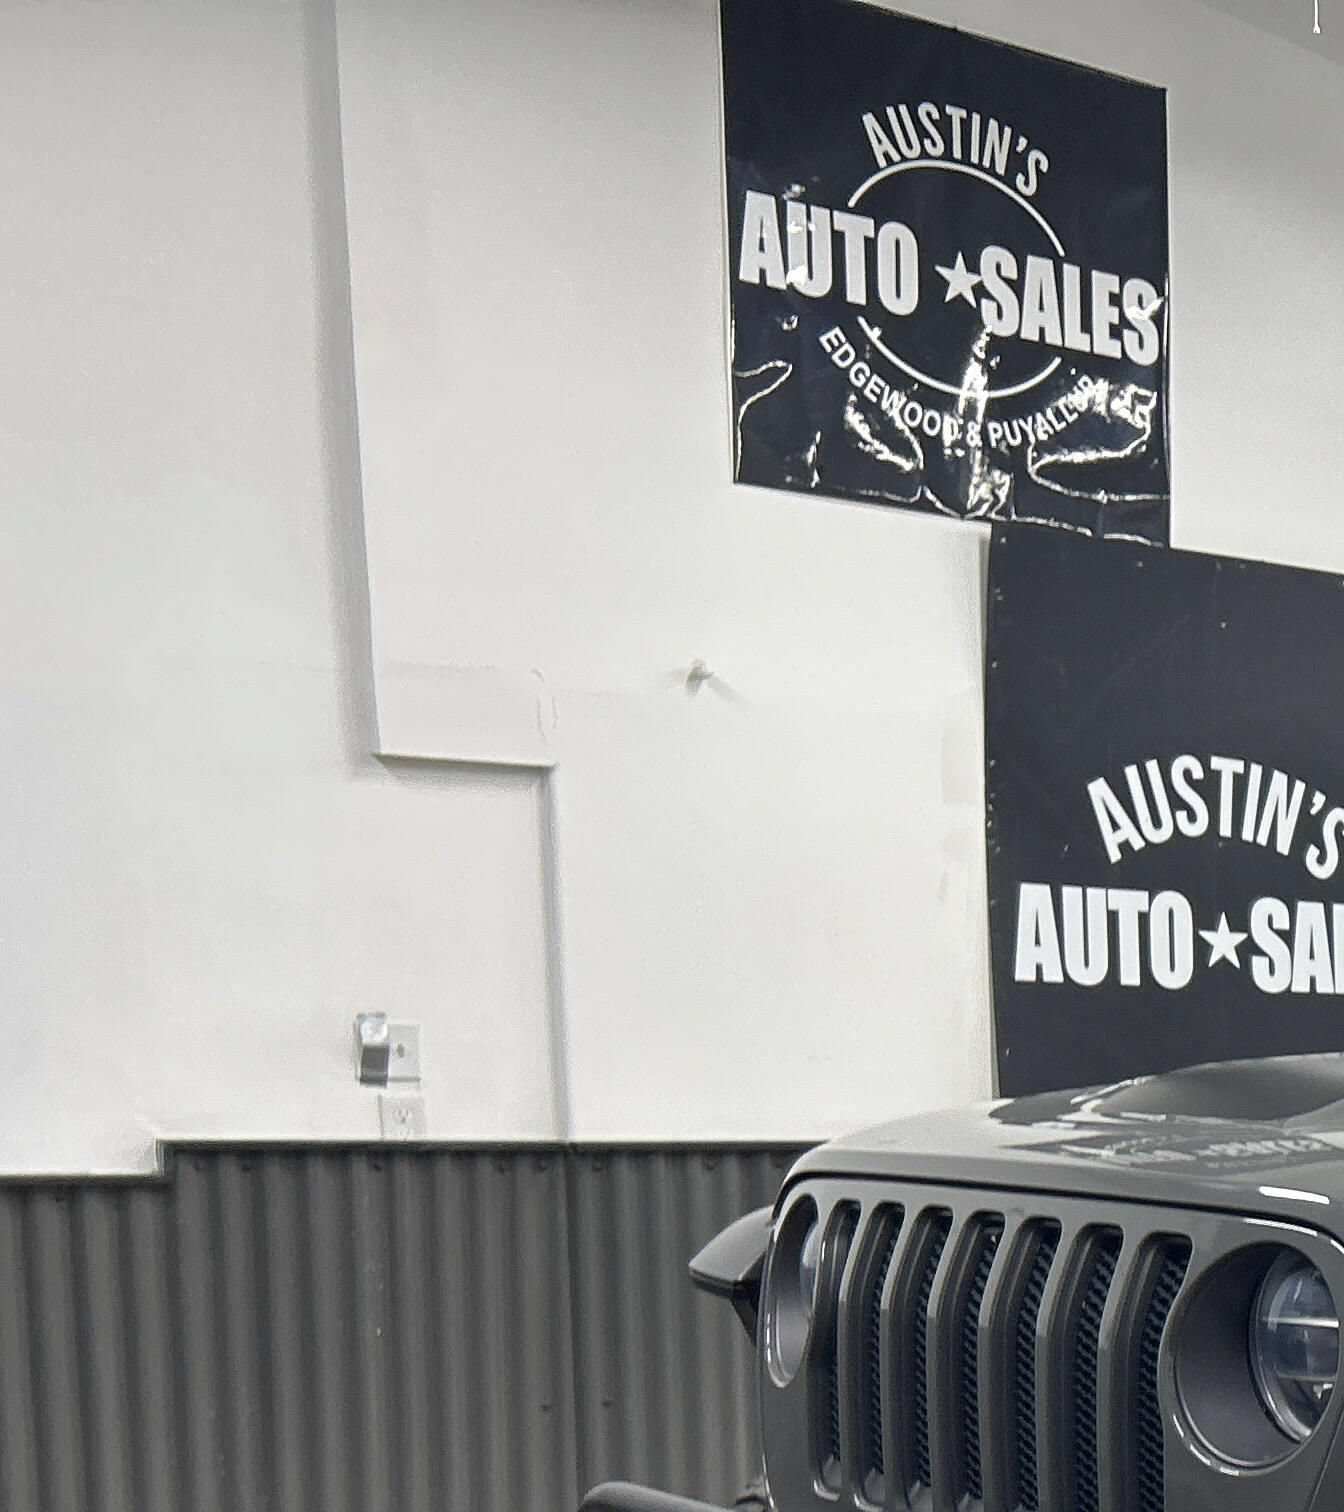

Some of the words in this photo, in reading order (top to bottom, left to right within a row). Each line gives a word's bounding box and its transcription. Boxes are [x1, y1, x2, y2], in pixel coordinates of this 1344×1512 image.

[862, 102, 1050, 198] AUSTIN'S
[738, 189, 919, 317] AUTO
[979, 245, 1161, 367] SALES
[818, 326, 962, 446] EDGEWOOD
[966, 422, 983, 447] &
[987, 375, 1102, 448] PUYALLUP
[1014, 882, 1194, 990] AUTO
